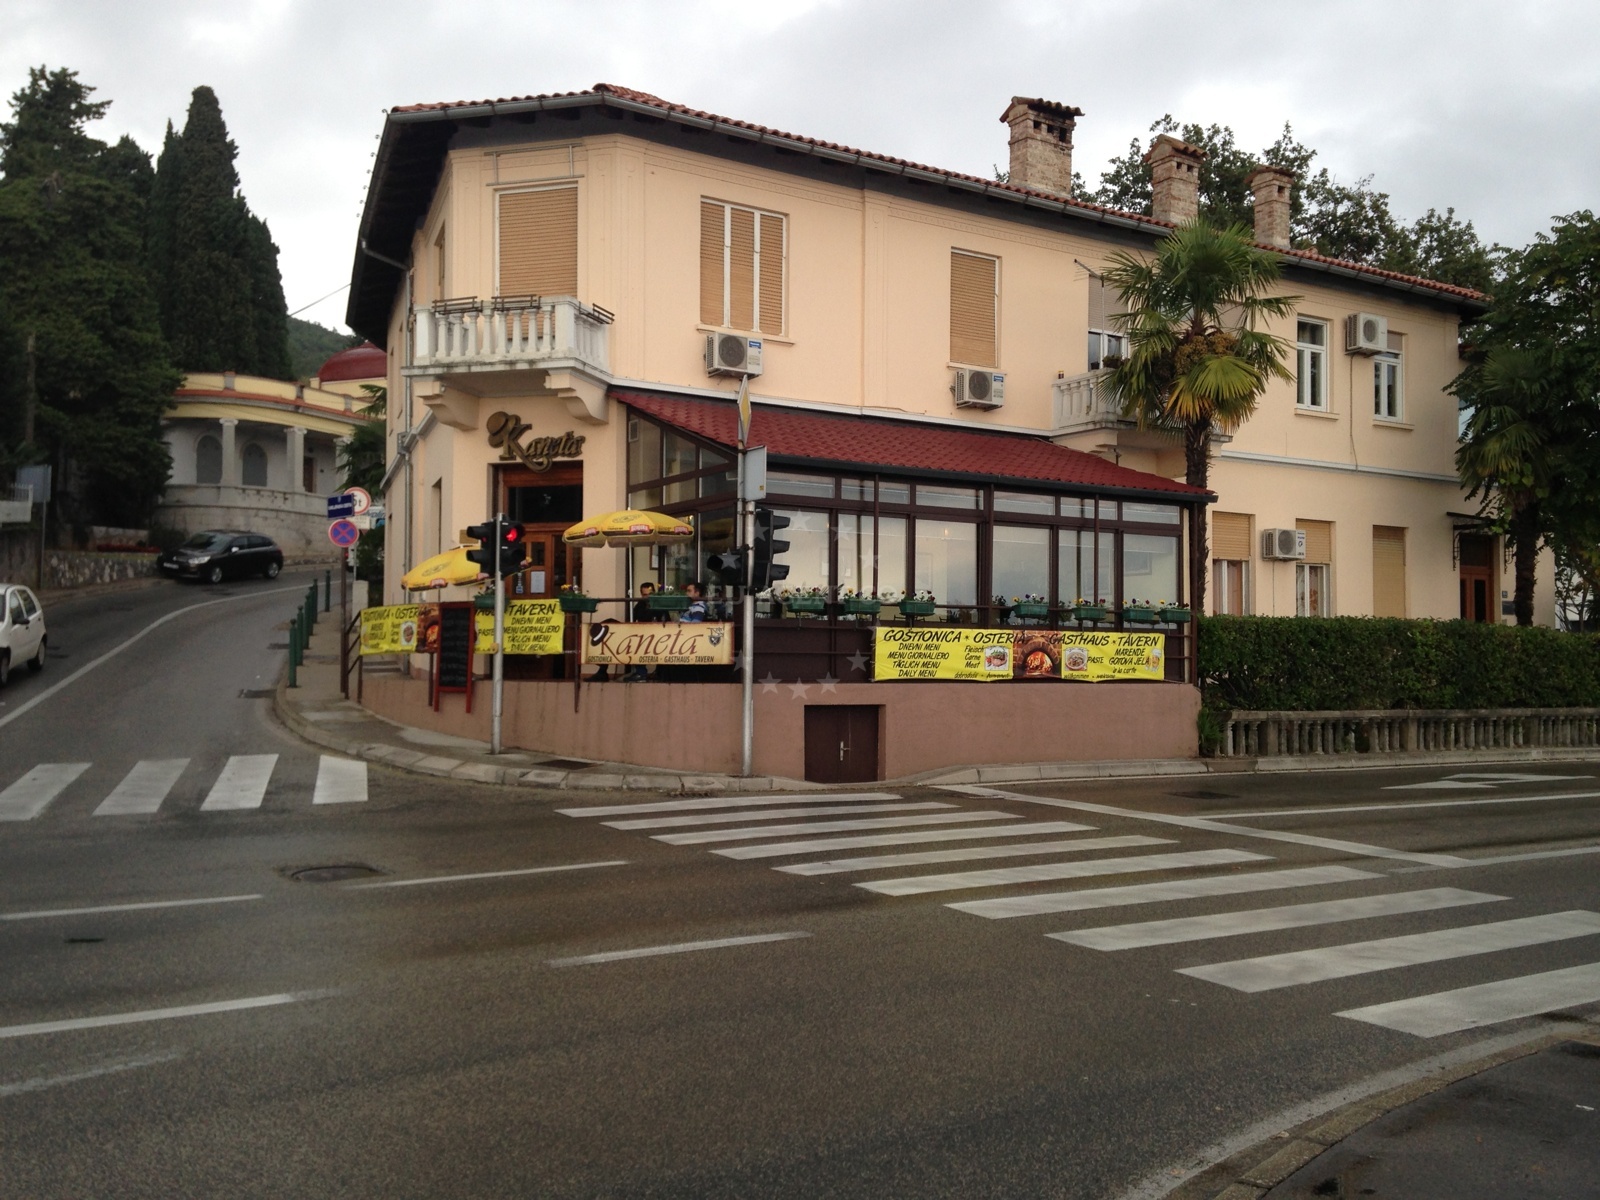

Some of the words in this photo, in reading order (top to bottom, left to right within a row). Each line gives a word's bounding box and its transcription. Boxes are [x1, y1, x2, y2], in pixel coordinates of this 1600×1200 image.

[498, 414, 586, 473] Kaneta
[508, 603, 557, 616] TAVERN
[511, 616, 533, 625] DNEVNI
[532, 635, 551, 643] MENU
[973, 632, 1025, 644] OSTERIA
[1050, 633, 1110, 646] GASTHAUS
[1117, 635, 1160, 647] TAVERN
[599, 627, 704, 664] Kaneta
[898, 643, 922, 651] DNEVNI
[925, 643, 941, 651] MENI
[887, 651, 906, 659] MENU
[907, 651, 950, 660] GIORNALIERO
[1114, 648, 1145, 657] MARENDE
[638, 655, 659, 663] OSTERIA
[664, 655, 691, 663] GASTHAUS
[695, 655, 715, 663] TAVERN
[1087, 656, 1104, 664] PASTE
[1109, 656, 1133, 665] GOTOVA
[920, 661, 941, 669] MENU
